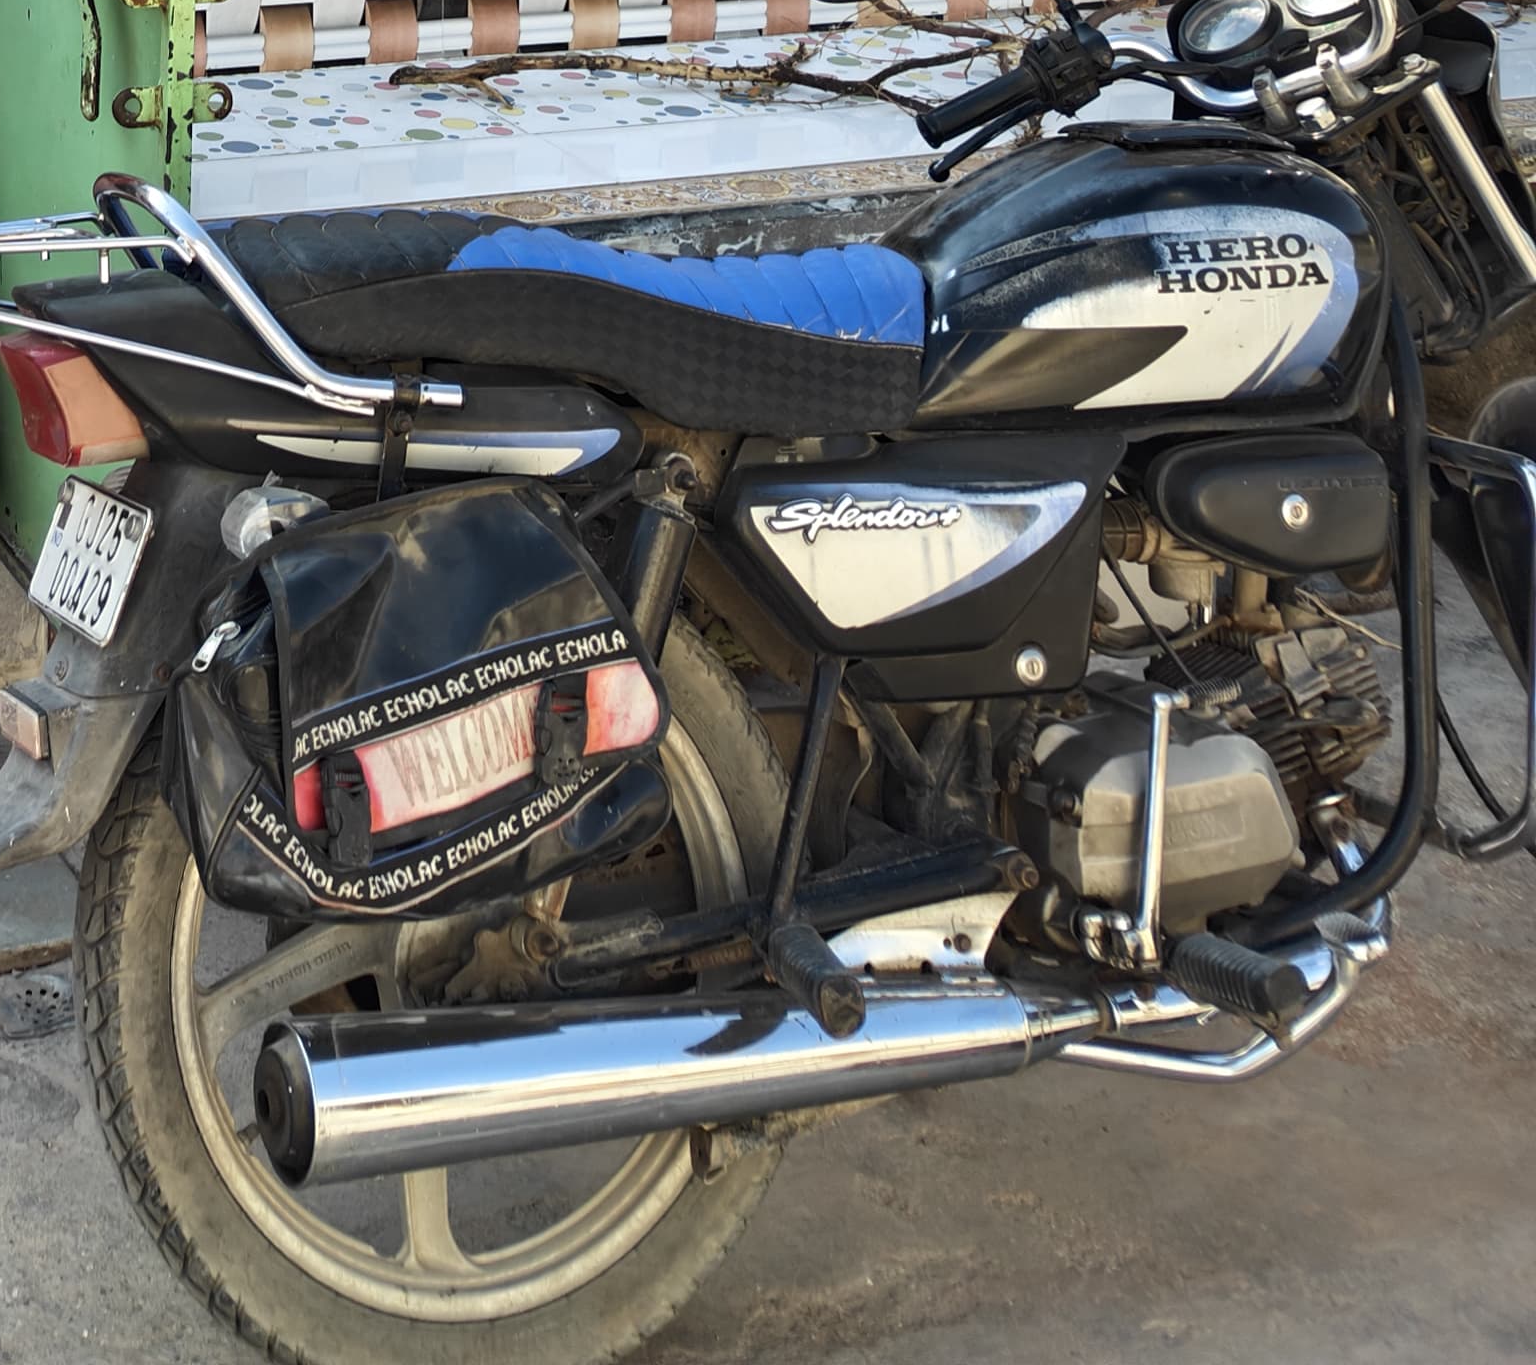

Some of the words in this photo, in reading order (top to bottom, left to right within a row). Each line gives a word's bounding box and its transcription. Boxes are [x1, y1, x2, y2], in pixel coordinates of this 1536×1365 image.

[1155, 262, 1329, 294] HONDA
[1164, 233, 1308, 263] HERO
[76, 494, 129, 562] GJ25
[292, 735, 310, 763] AC
[312, 706, 383, 751] ECHOLAC
[384, 673, 475, 723] ECHOLAC
[476, 647, 554, 691] ECHOLAC
[556, 629, 629, 666] ECHOLA
[385, 693, 537, 807] WELCOM
[283, 835, 365, 900] ECHOLAC
[369, 859, 444, 901] ECHOLAC
[447, 815, 521, 870] ECHOLAC
